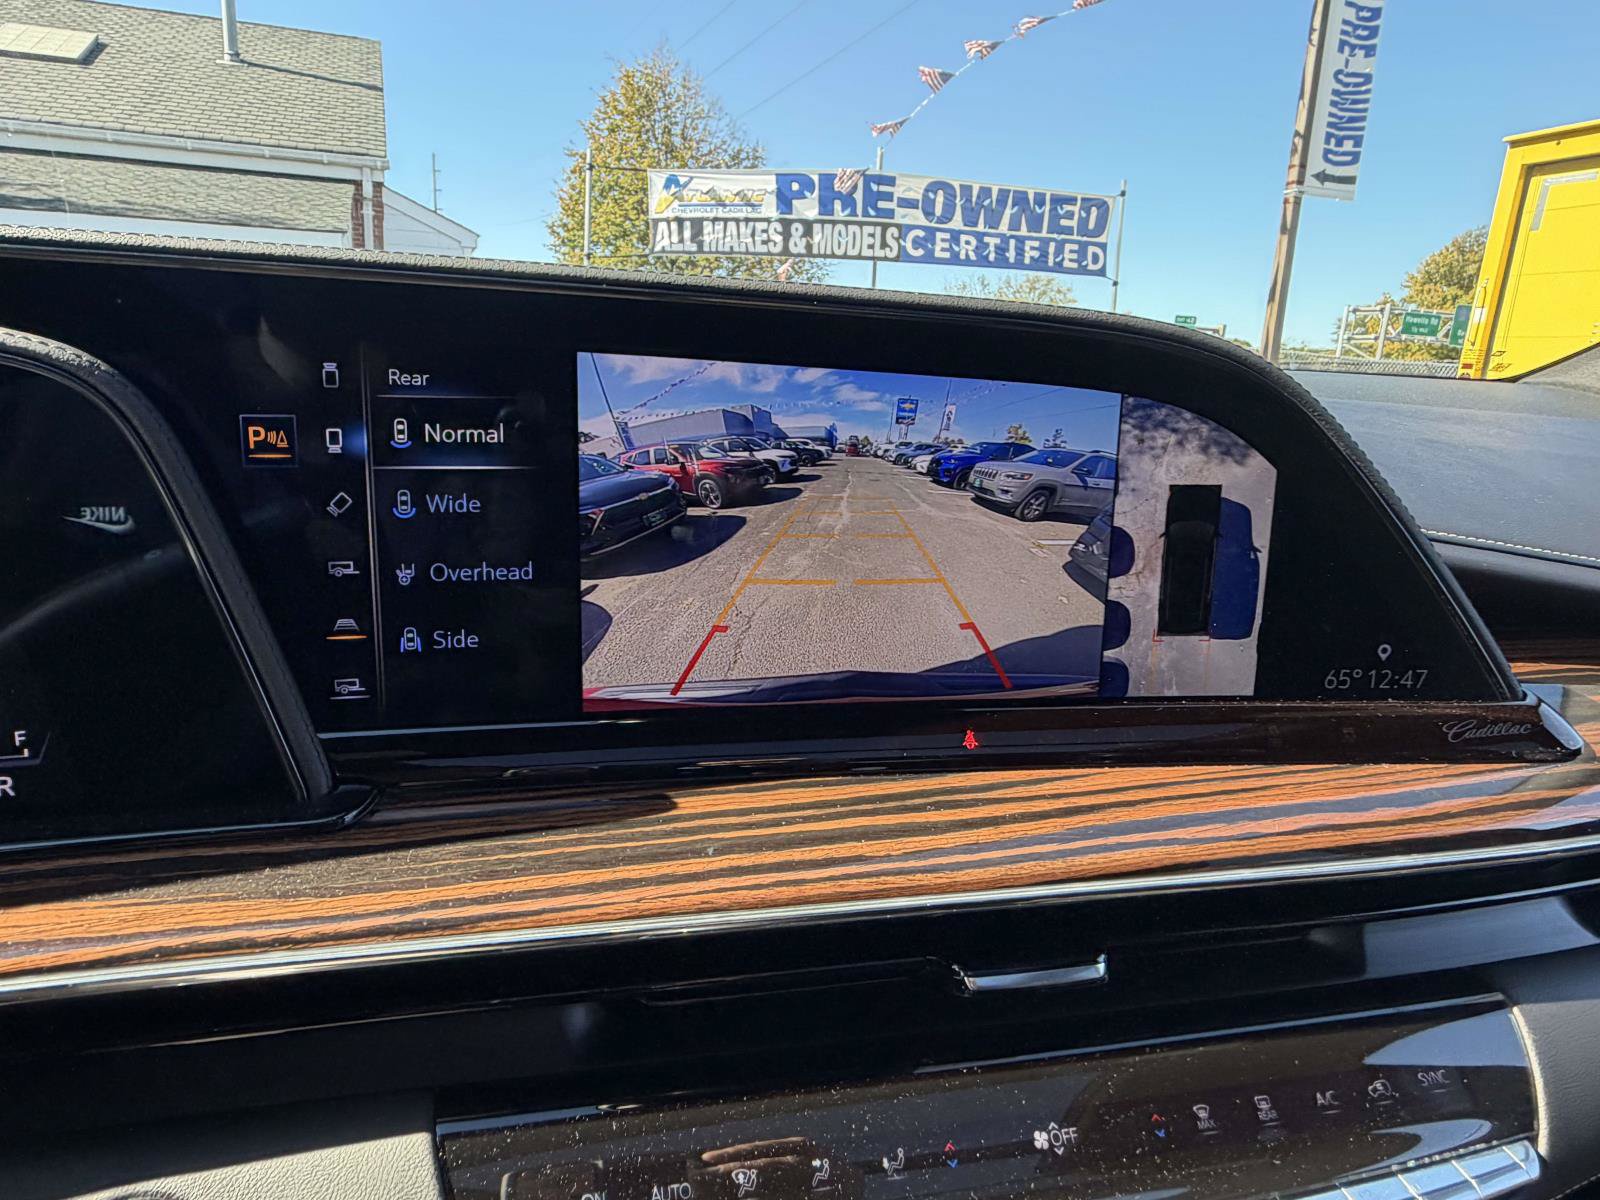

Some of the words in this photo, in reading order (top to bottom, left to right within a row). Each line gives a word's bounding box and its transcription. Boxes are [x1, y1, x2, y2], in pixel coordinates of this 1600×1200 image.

[1322, 0, 1383, 166] PRE-OWNED
[671, 206, 720, 214] CHEVROLET
[721, 206, 762, 215] CADILLAC
[775, 173, 1110, 239] PRE-OWNED
[653, 221, 698, 253] ALL
[702, 220, 783, 254] MAKES
[788, 222, 807, 254] &
[812, 223, 899, 259] MODELS
[905, 229, 1105, 271] CERTIFIED
[388, 369, 430, 386] Rear
[424, 423, 504, 444] Normal
[426, 493, 481, 513] Wide
[430, 560, 533, 582] Overhead
[433, 628, 479, 648] Side
[1324, 669, 1363, 689] 65°
[1369, 669, 1428, 689] 12:47
[14, 730, 26, 747] F
[1442, 719, 1532, 743] Cadillac
[0, 776, 16, 797] R
[1417, 1069, 1451, 1087] SYNC
[1316, 1090, 1339, 1106] A/C
[1196, 1118, 1217, 1130] MAX
[1050, 1127, 1078, 1146] OFF
[651, 1182, 692, 1200] AUTO
